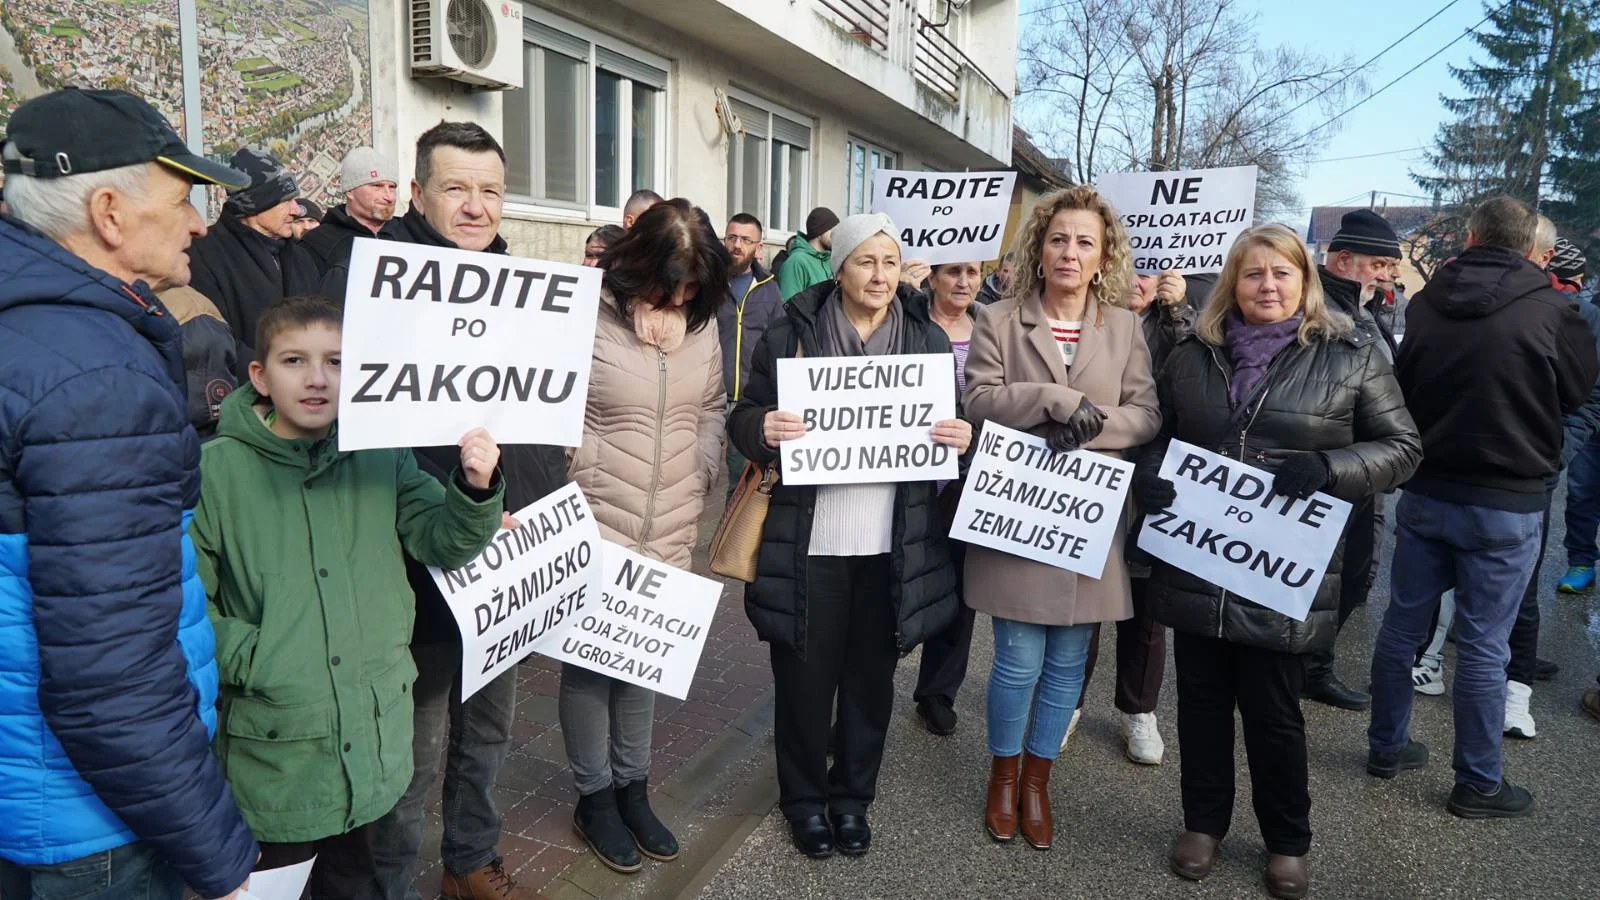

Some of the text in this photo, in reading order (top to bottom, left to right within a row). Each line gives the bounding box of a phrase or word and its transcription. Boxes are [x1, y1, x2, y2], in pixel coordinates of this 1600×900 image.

[510, 8, 520, 19] LG
[886, 177, 1003, 200] RADITE
[1150, 177, 1202, 205] NE
[931, 205, 953, 216] PO
[1119, 208, 1246, 228] SPLOATACIJI
[901, 223, 1000, 247] AKONU
[1129, 232, 1227, 249] OJA ŽIVOT
[1134, 254, 1223, 271] GROŽAVA
[370, 255, 579, 314] RADITE
[451, 318, 487, 338] PO
[350, 363, 578, 404] ZAKONU
[808, 361, 924, 391] VIJEĆNICI
[803, 403, 933, 432] BUDITE UZ
[790, 443, 949, 472] SVOJ NAROD
[979, 431, 1125, 491] NE OTIMAJTE
[974, 470, 1104, 524] DŽAMIJSKO
[1224, 505, 1253, 523] PO
[441, 493, 585, 594] NE OTIMAJTE
[968, 508, 1088, 559] ZEMLJIŠTE
[1148, 510, 1315, 588] ZAKONU
[474, 540, 591, 637] DŽAMIJSKO
[614, 558, 668, 599] NE
[481, 583, 587, 675] ZEMLJIŠTE
[602, 592, 701, 641] PLOATACIJI
[581, 616, 675, 658] OJA ŽIVOT
[562, 637, 663, 684] UGROŽAVA
